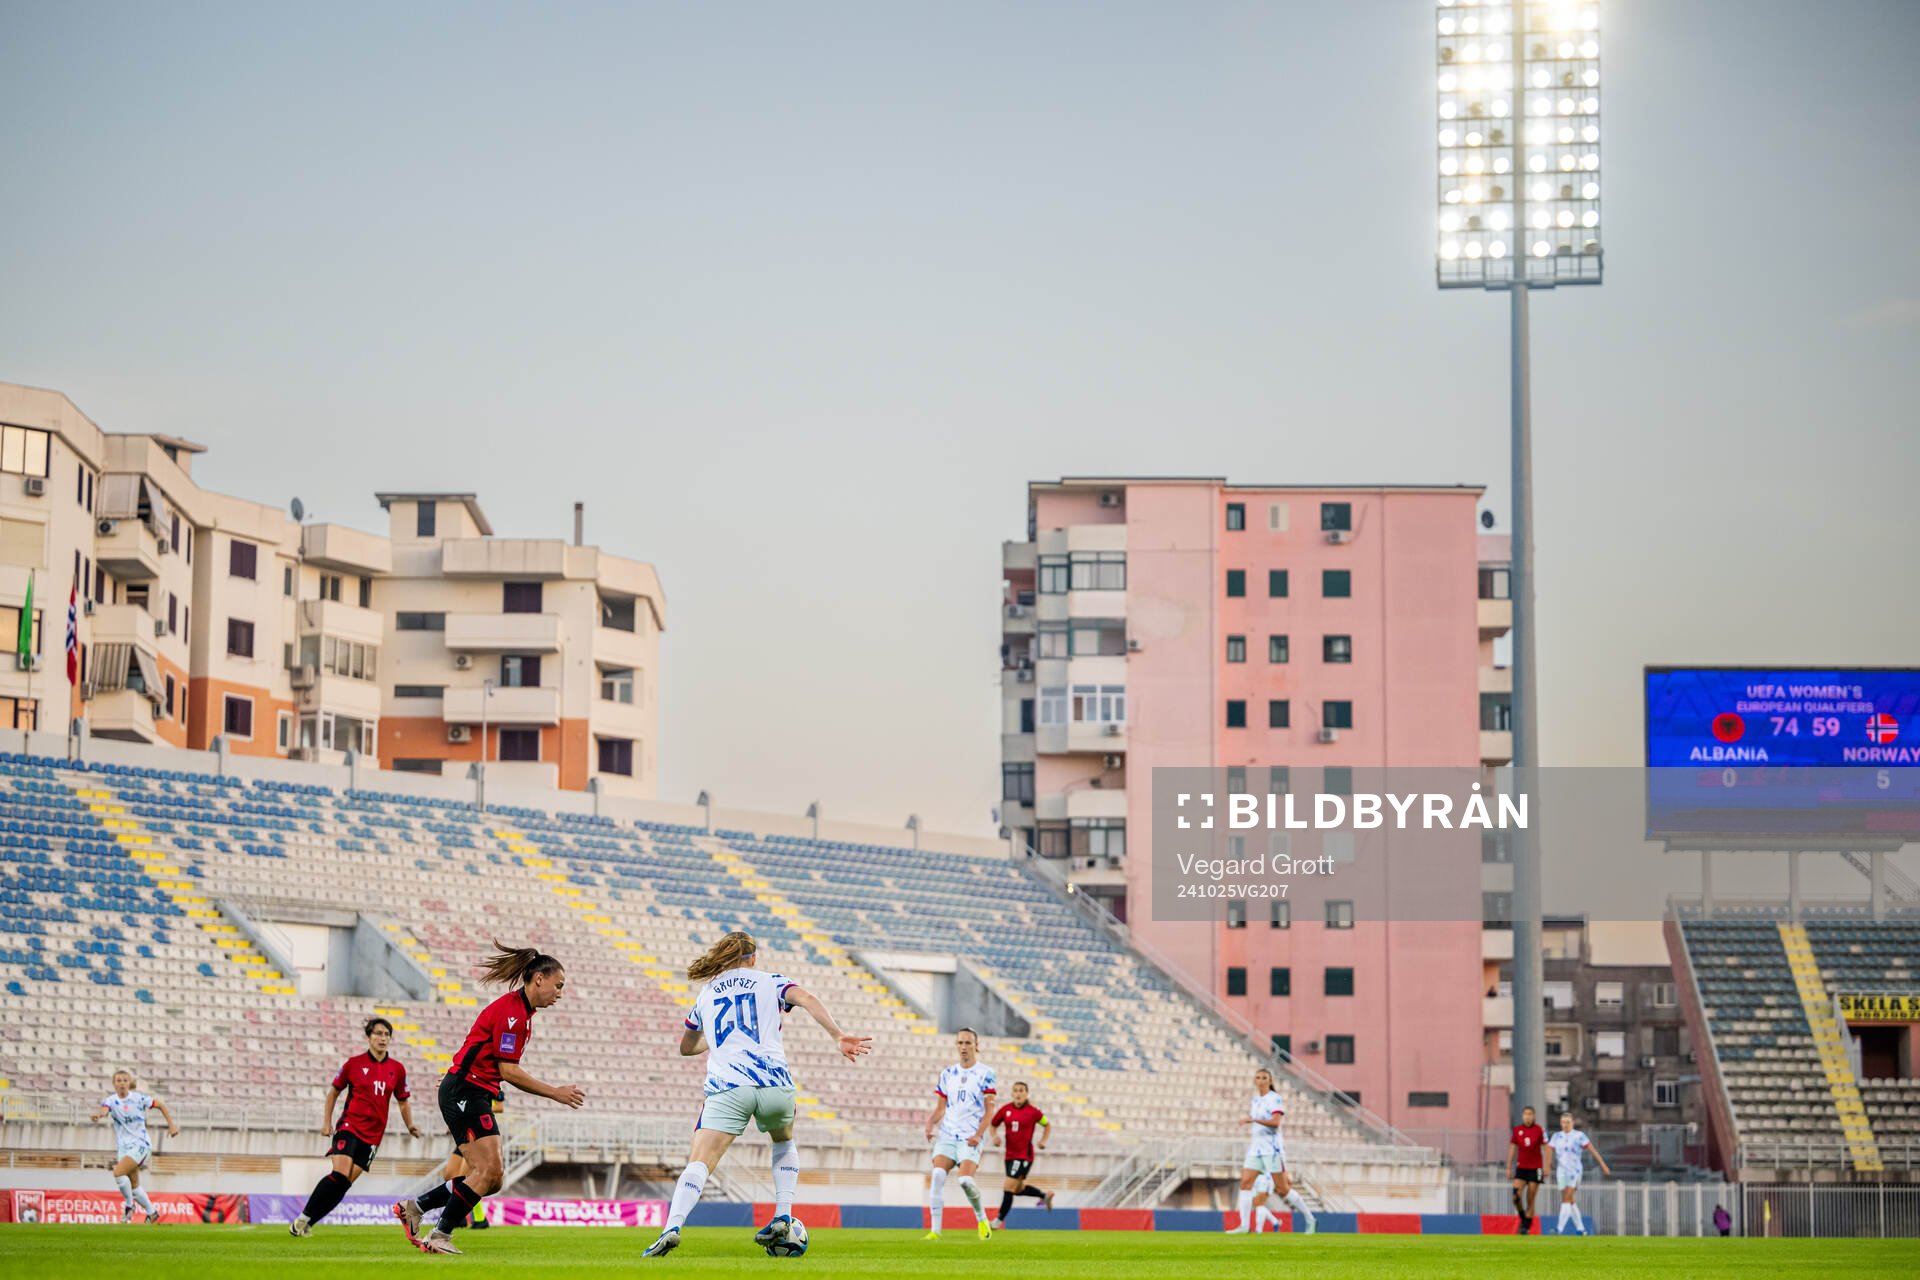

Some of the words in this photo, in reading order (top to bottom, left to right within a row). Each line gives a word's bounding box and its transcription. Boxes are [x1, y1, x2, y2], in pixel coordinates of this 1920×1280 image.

[1747, 685, 1786, 699] UEFA
[1736, 701, 1801, 713] EUROPEAN
[1804, 701, 1874, 714] QUALIFIERS
[1770, 717, 1799, 737] 74
[1812, 717, 1840, 737] 59
[1690, 746, 1768, 761] ALBANIA
[1843, 747, 1920, 762] NORWAY
[1722, 769, 1736, 788] 0
[1877, 769, 1890, 789] 5
[713, 993, 760, 1048] 20
[373, 1080, 386, 1096] 14
[47, 1199, 117, 1213] FEDERATA
